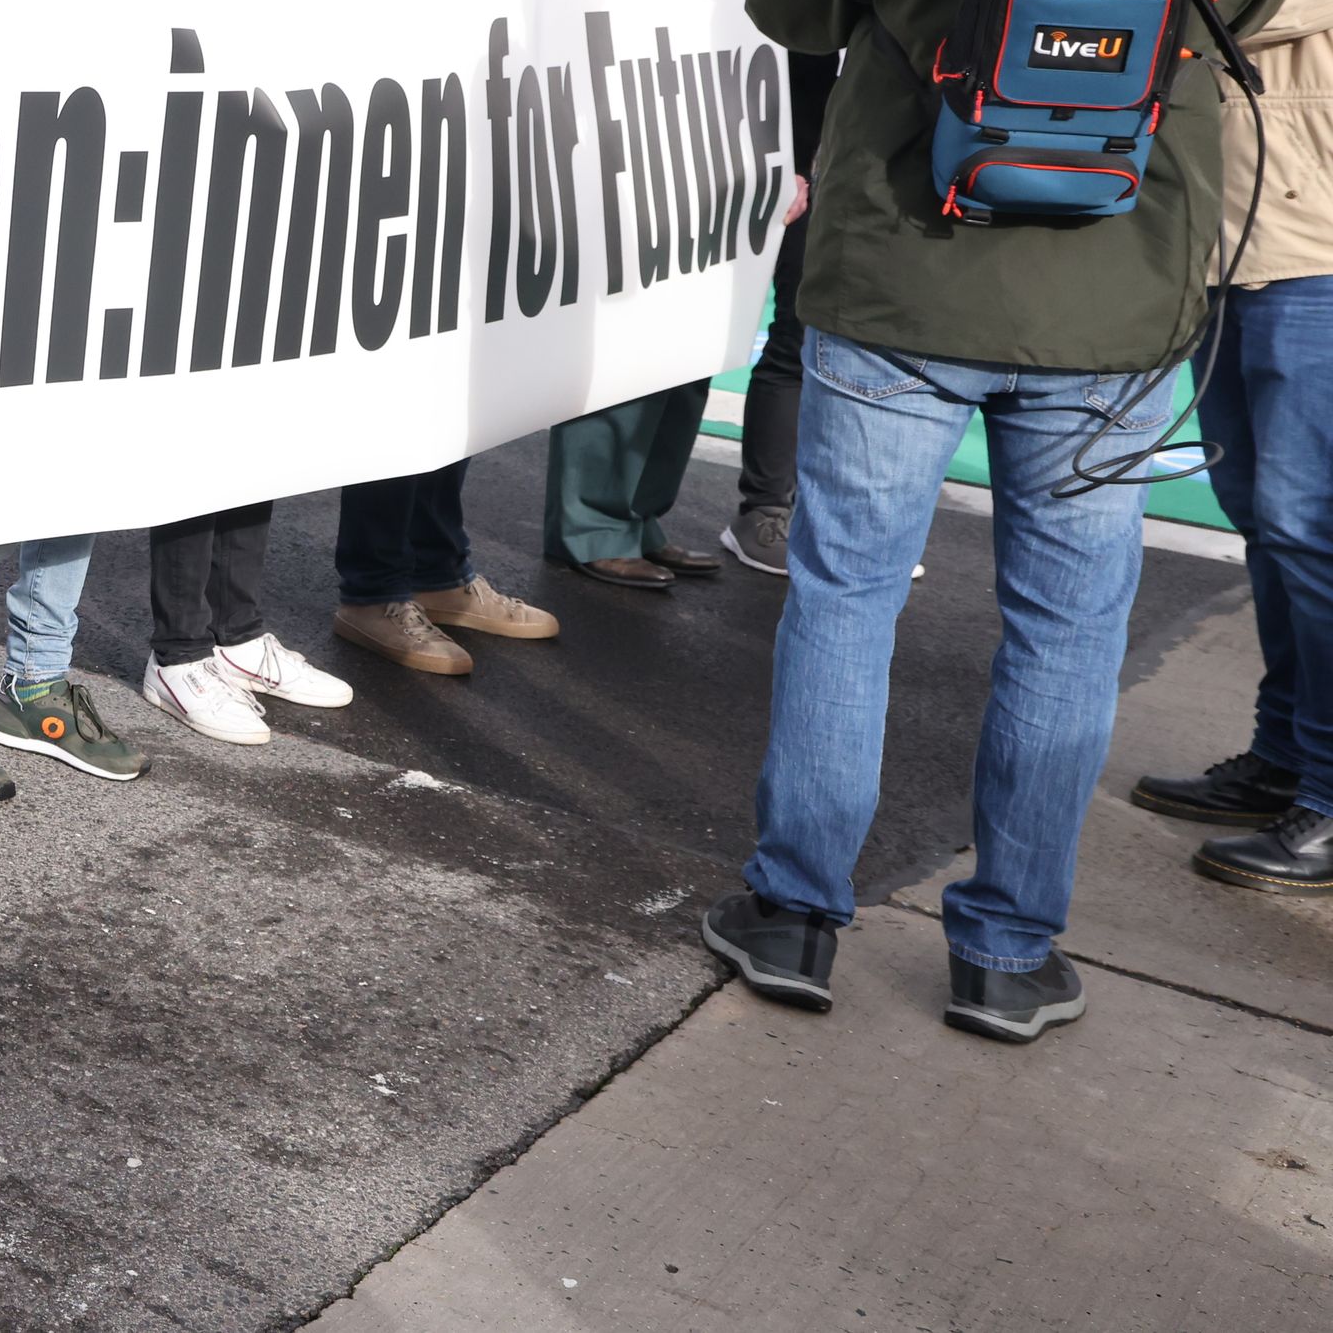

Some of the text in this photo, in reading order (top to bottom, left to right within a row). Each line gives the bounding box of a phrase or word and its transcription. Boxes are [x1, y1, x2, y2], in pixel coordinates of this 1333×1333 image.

[1034, 31, 1123, 59] LiveU
[484, 17, 580, 323] for
[584, 11, 783, 295] Future
